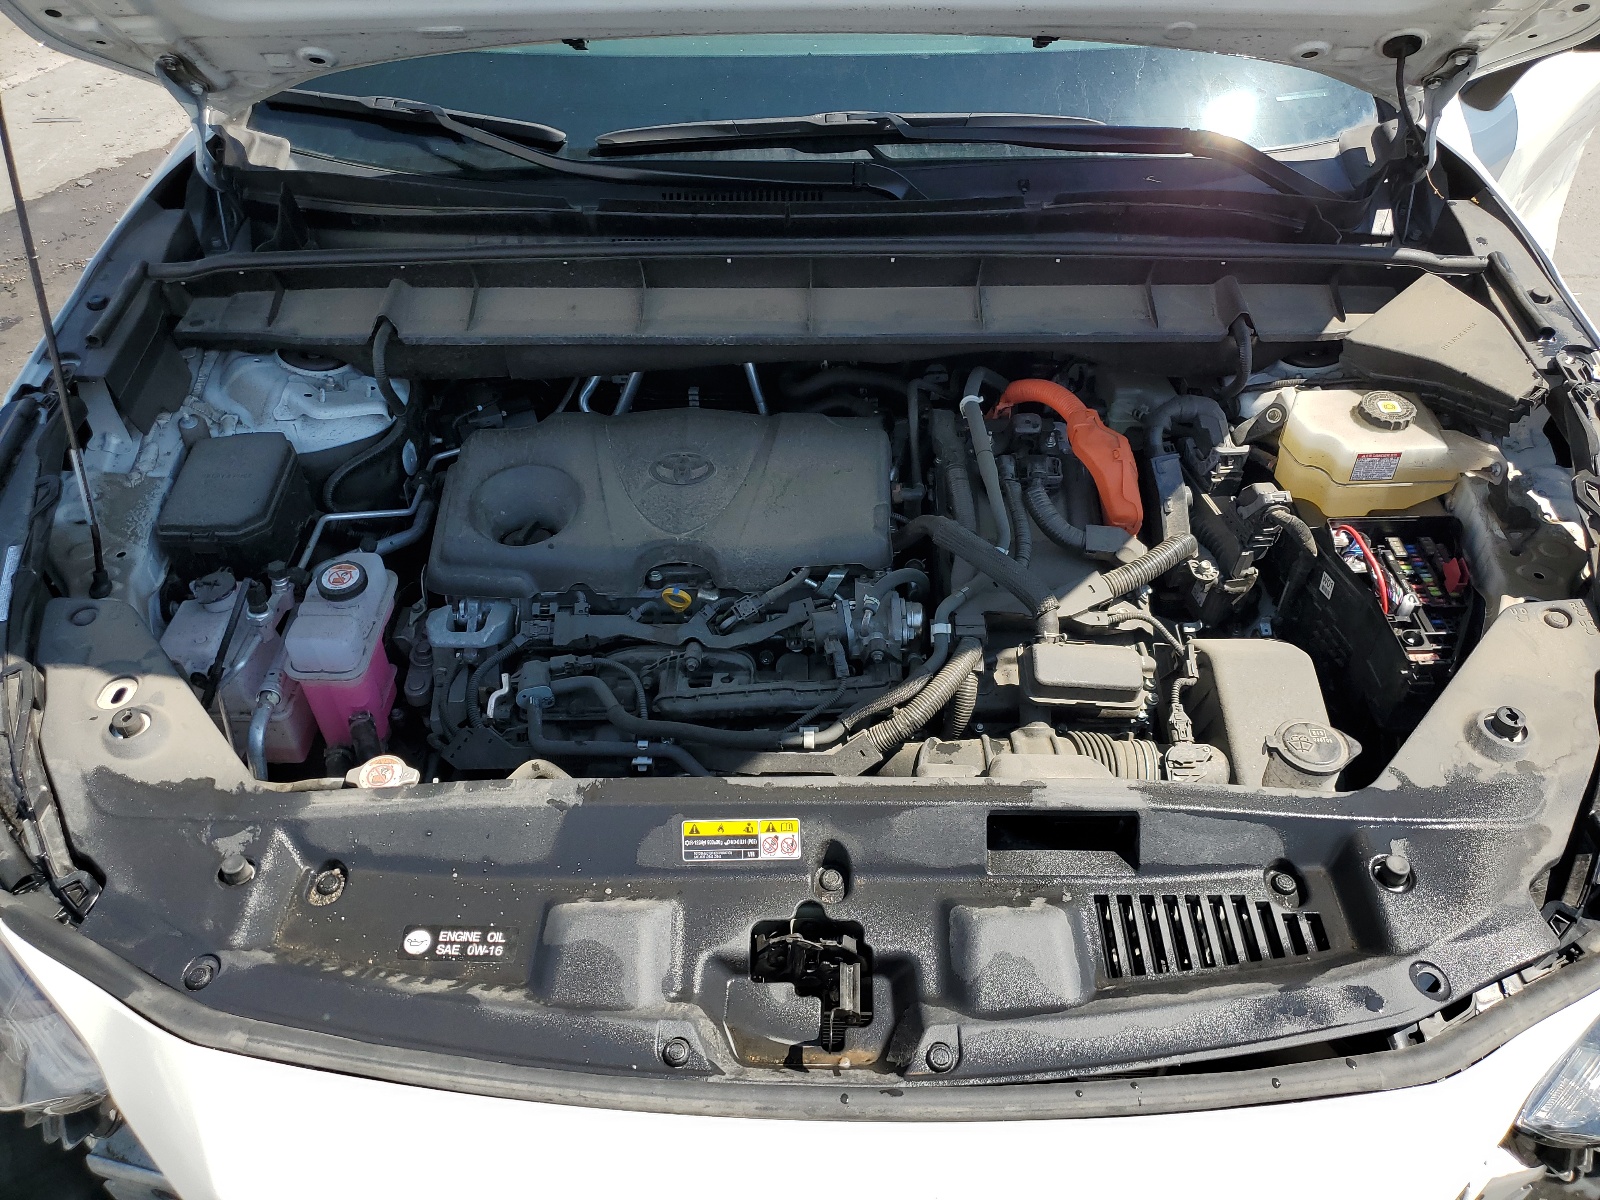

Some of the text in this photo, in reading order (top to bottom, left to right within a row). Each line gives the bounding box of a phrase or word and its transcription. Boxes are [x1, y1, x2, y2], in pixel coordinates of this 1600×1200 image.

[438, 930, 506, 943] ENGINE OIL
[435, 944, 504, 956] SAE 0W-16
